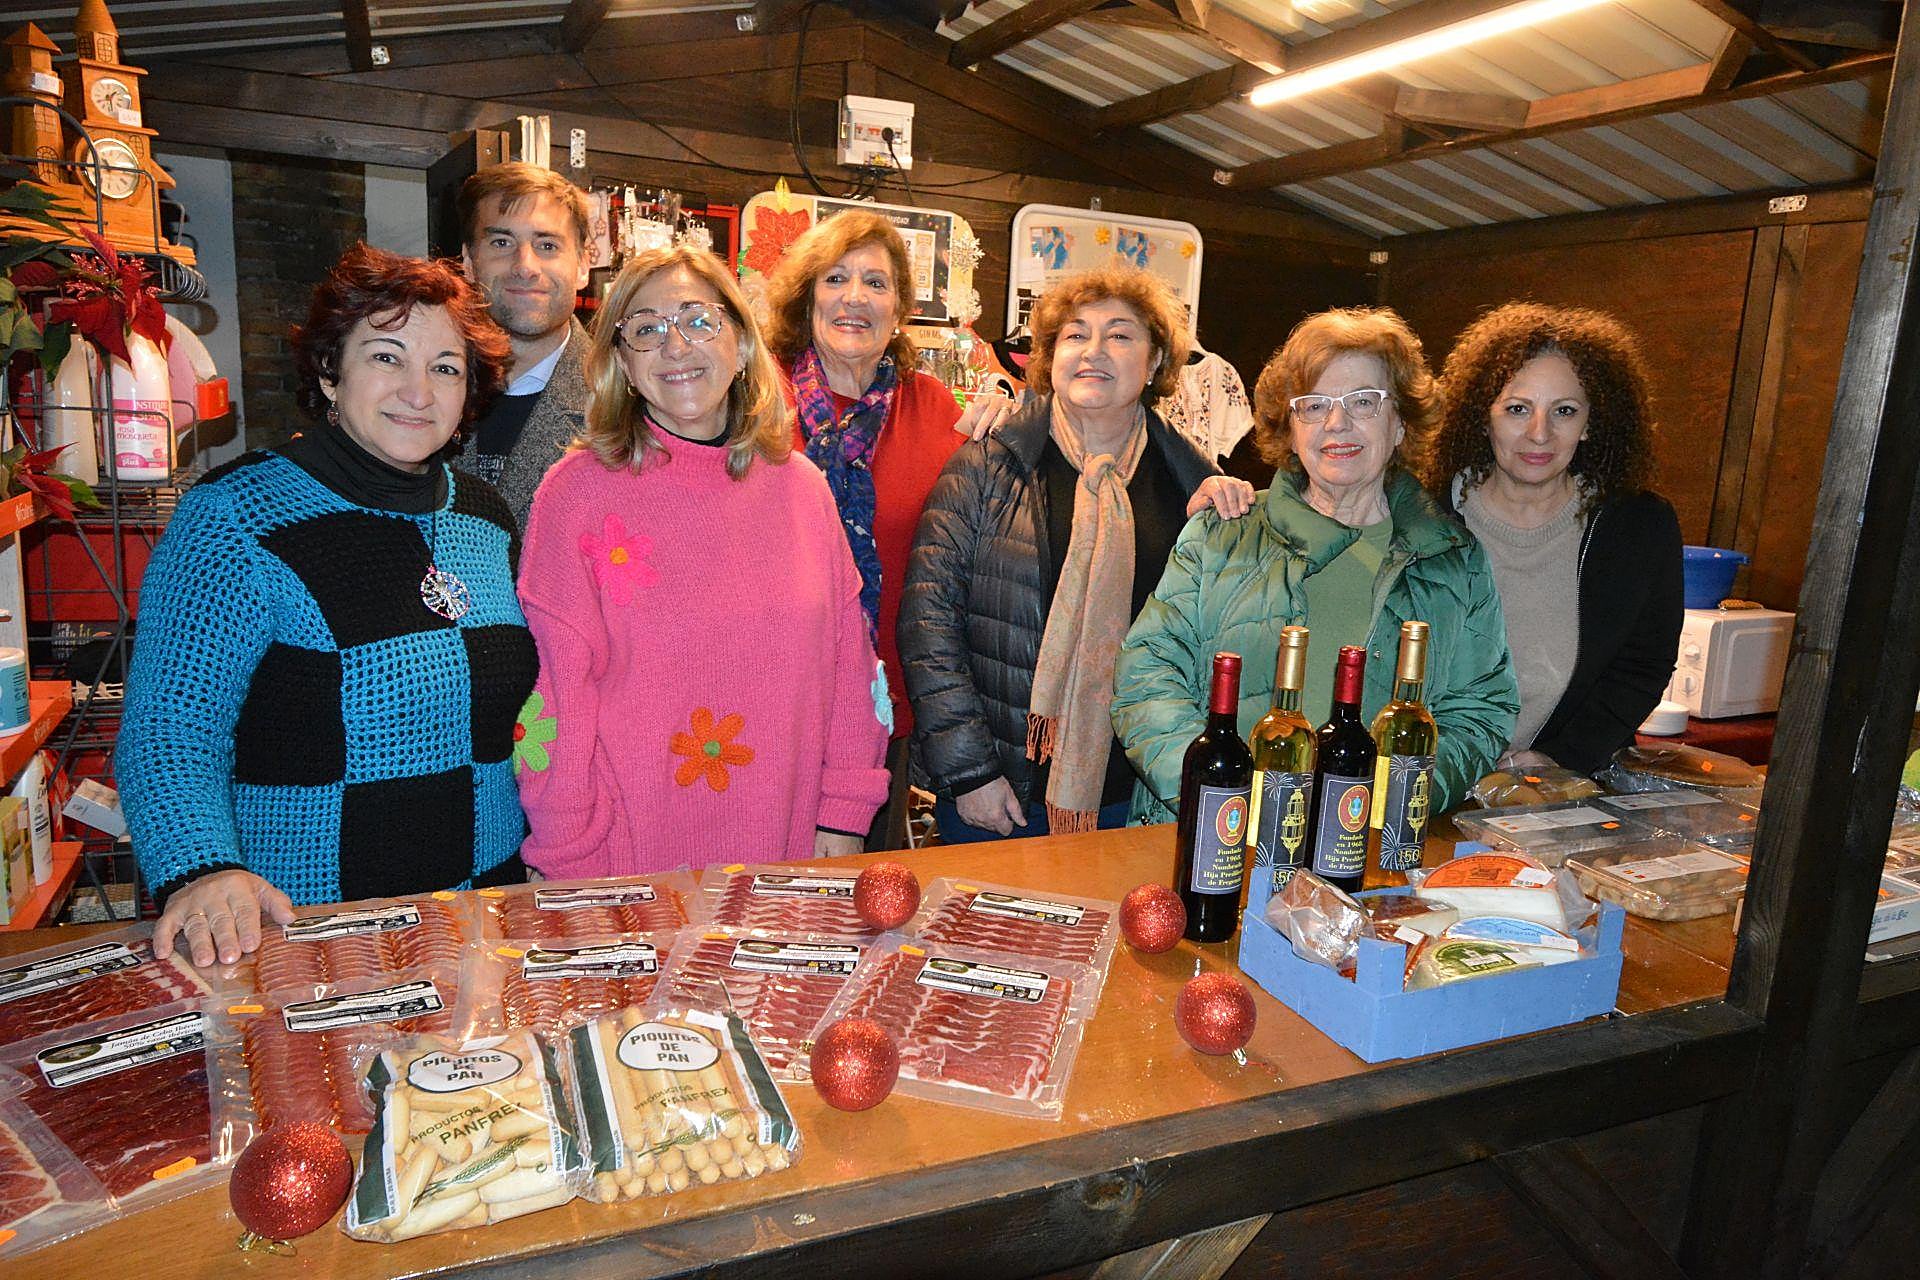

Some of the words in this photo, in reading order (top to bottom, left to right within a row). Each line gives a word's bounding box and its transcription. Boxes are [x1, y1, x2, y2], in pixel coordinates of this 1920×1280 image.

[111, 1038, 139, 1049] Jamón
[152, 1029, 173, 1038] Cebo
[629, 1032, 701, 1046] PIQUITOS
[659, 1042, 681, 1052] DE
[656, 1053, 690, 1063] PAN
[447, 1071, 484, 1081] PAN
[659, 1087, 731, 1108] PANFREX
